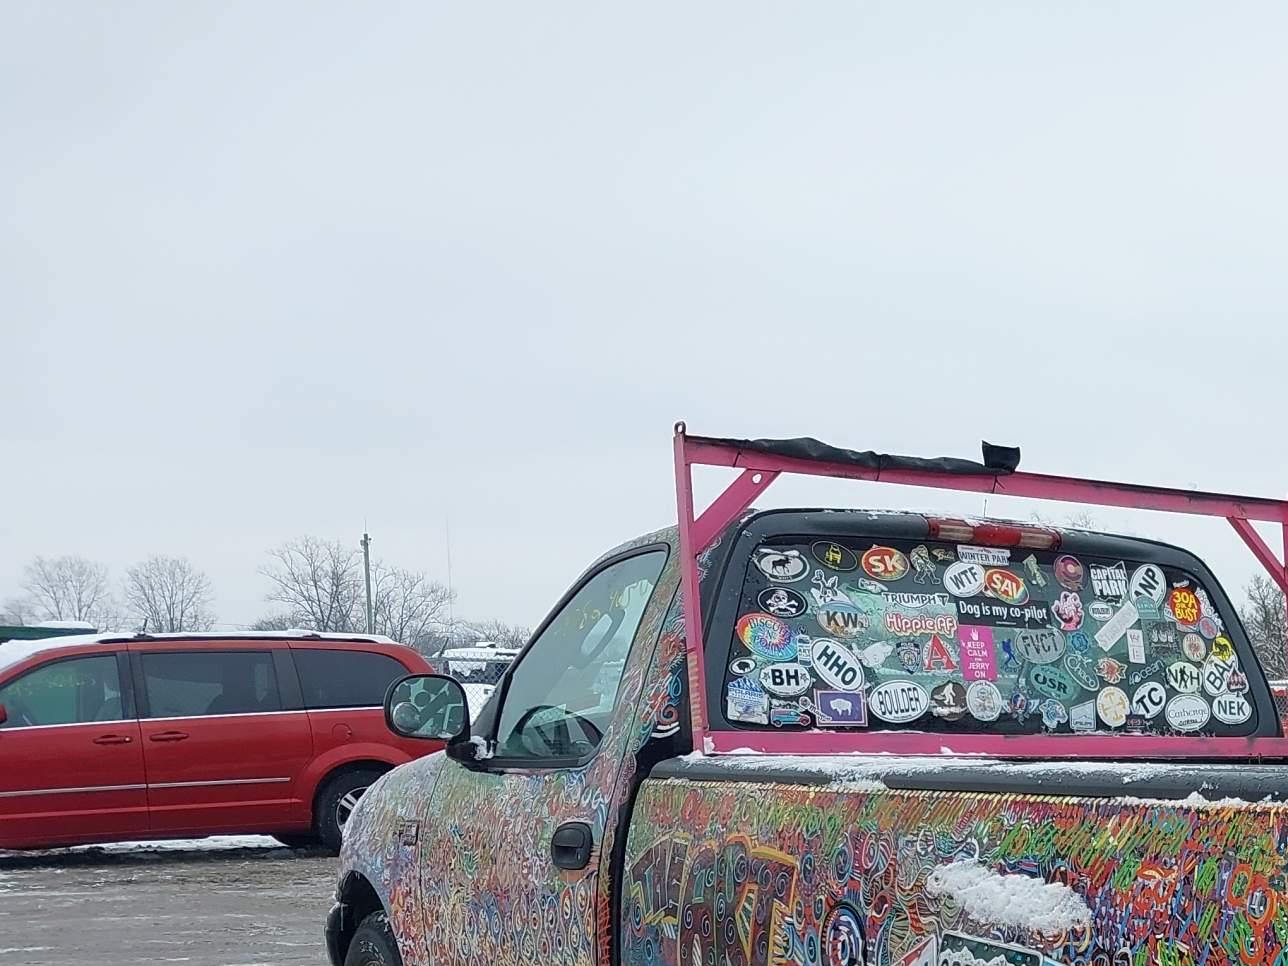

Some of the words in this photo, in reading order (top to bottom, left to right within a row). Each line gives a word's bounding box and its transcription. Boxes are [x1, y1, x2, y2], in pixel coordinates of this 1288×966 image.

[959, 551, 990, 562] WINTER
[950, 566, 978, 590] WTF
[1091, 568, 1126, 580] CAPITAL
[1095, 580, 1128, 596] PARK
[883, 593, 936, 607] TRIUMPH
[1173, 592, 1198, 607] 30A
[959, 601, 979, 618] Dog
[981, 603, 991, 613] is
[993, 606, 1008, 620] my
[1009, 606, 1047, 624] co-pilot
[1175, 607, 1198, 622] BUST
[967, 641, 985, 649] KEEP
[816, 644, 858, 686] HHO
[968, 662, 990, 670] JERRY
[770, 668, 800, 686] BH
[877, 686, 923, 716] BOULDER
[1135, 686, 1163, 714] TC
[1217, 700, 1246, 717] NEK
